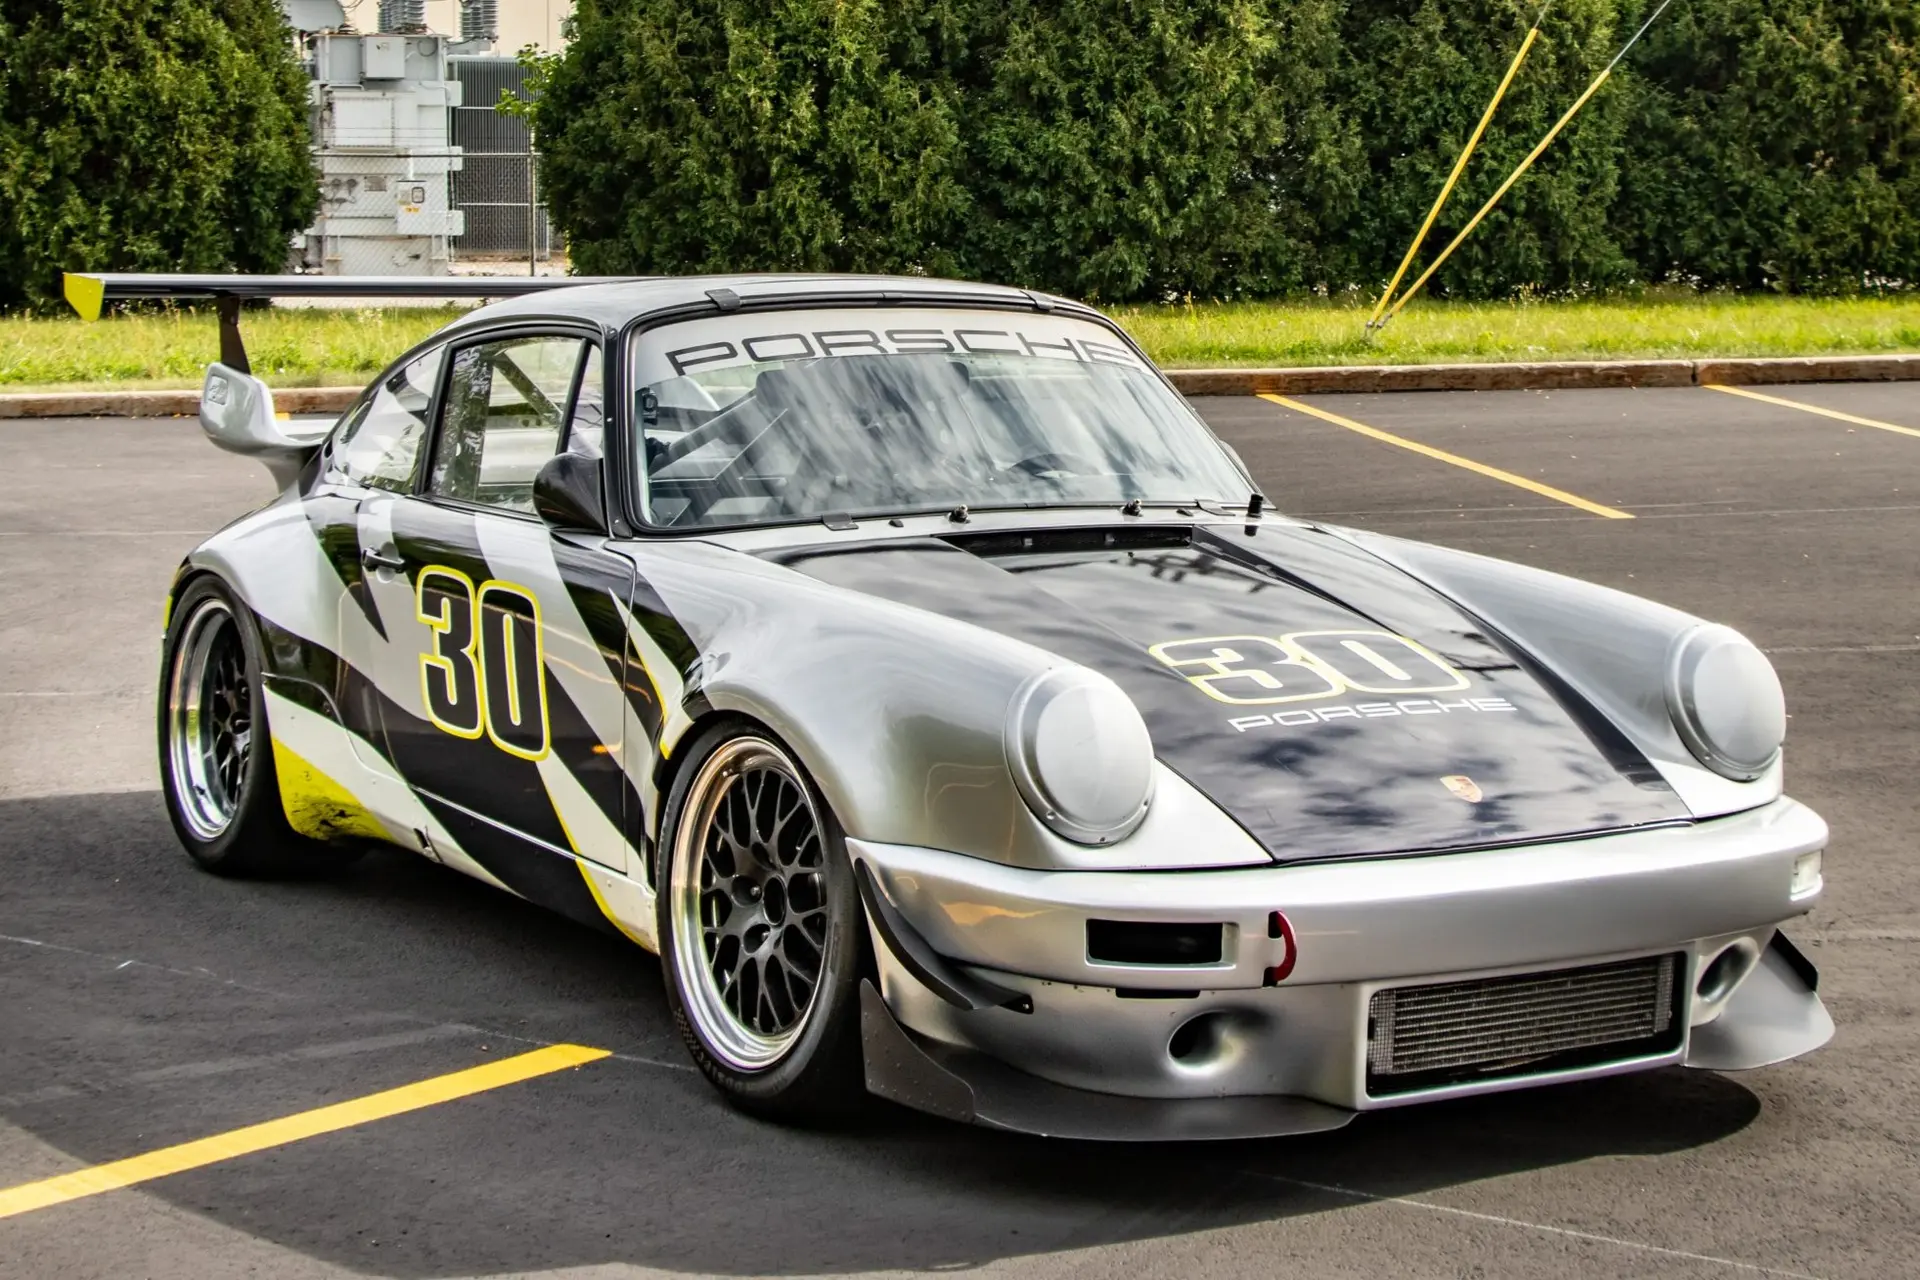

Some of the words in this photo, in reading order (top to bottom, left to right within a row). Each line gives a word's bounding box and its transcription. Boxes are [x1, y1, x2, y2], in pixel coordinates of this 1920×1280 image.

[665, 329, 1142, 376] PORSCHE
[416, 564, 551, 762] 30
[1148, 630, 1471, 704] 30
[1227, 697, 1518, 733] PORSCHE
